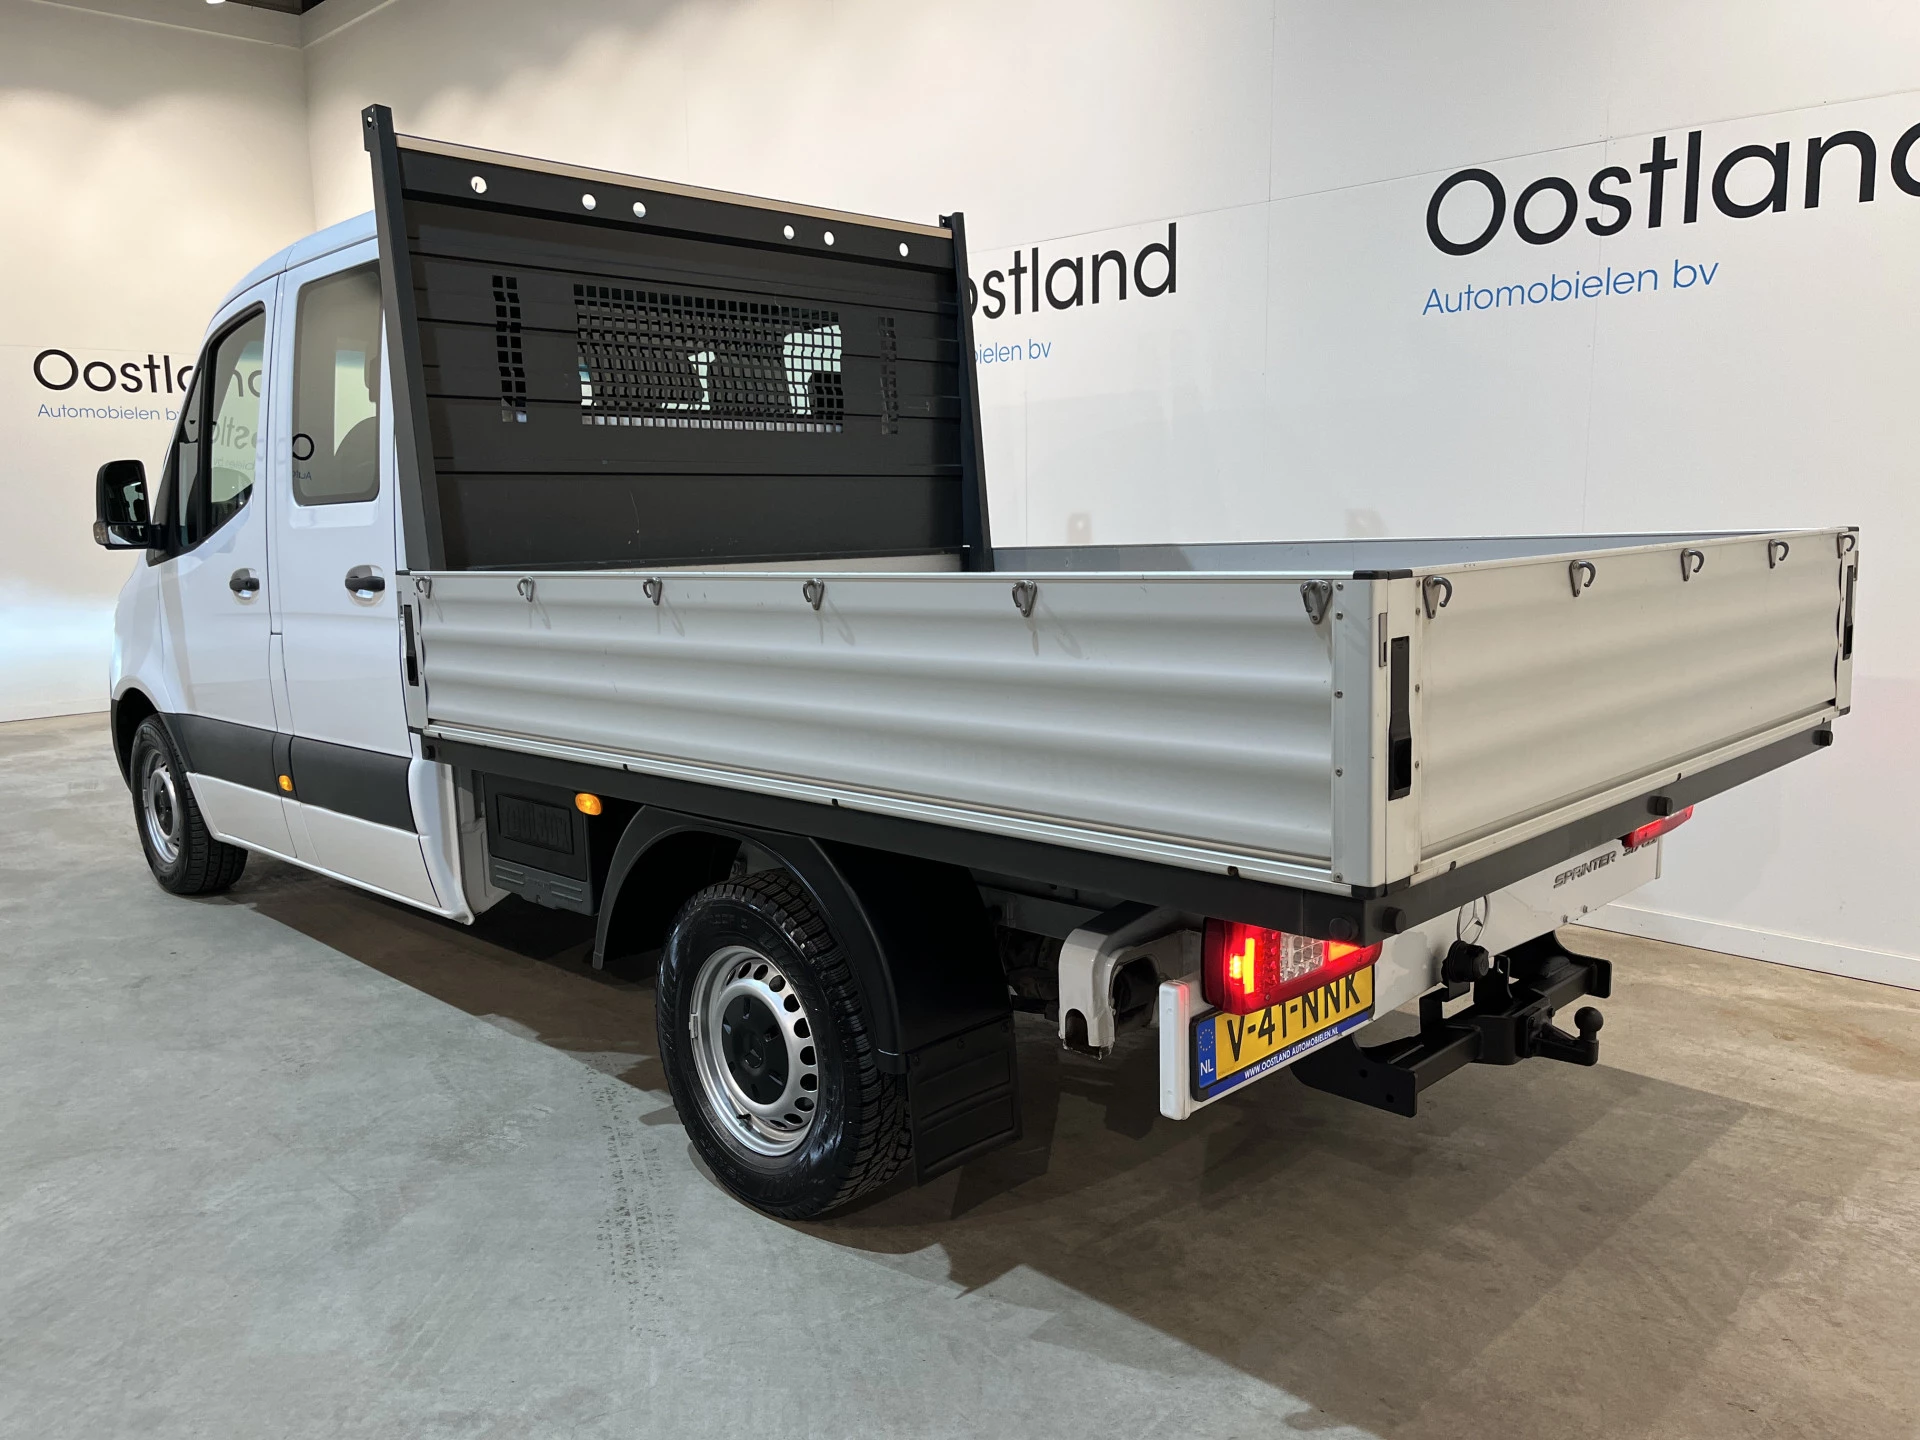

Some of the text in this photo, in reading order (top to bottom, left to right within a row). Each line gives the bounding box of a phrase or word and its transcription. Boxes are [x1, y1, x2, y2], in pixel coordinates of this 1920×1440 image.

[1422, 259, 1719, 316] Automobielen bv
[974, 338, 1052, 364] ielen bv
[37, 403, 161, 421] Automobielen
[1553, 851, 1617, 889] SPRINTER
[1227, 973, 1360, 1062] V-41-NNK
[1200, 1058, 1214, 1076] NL
